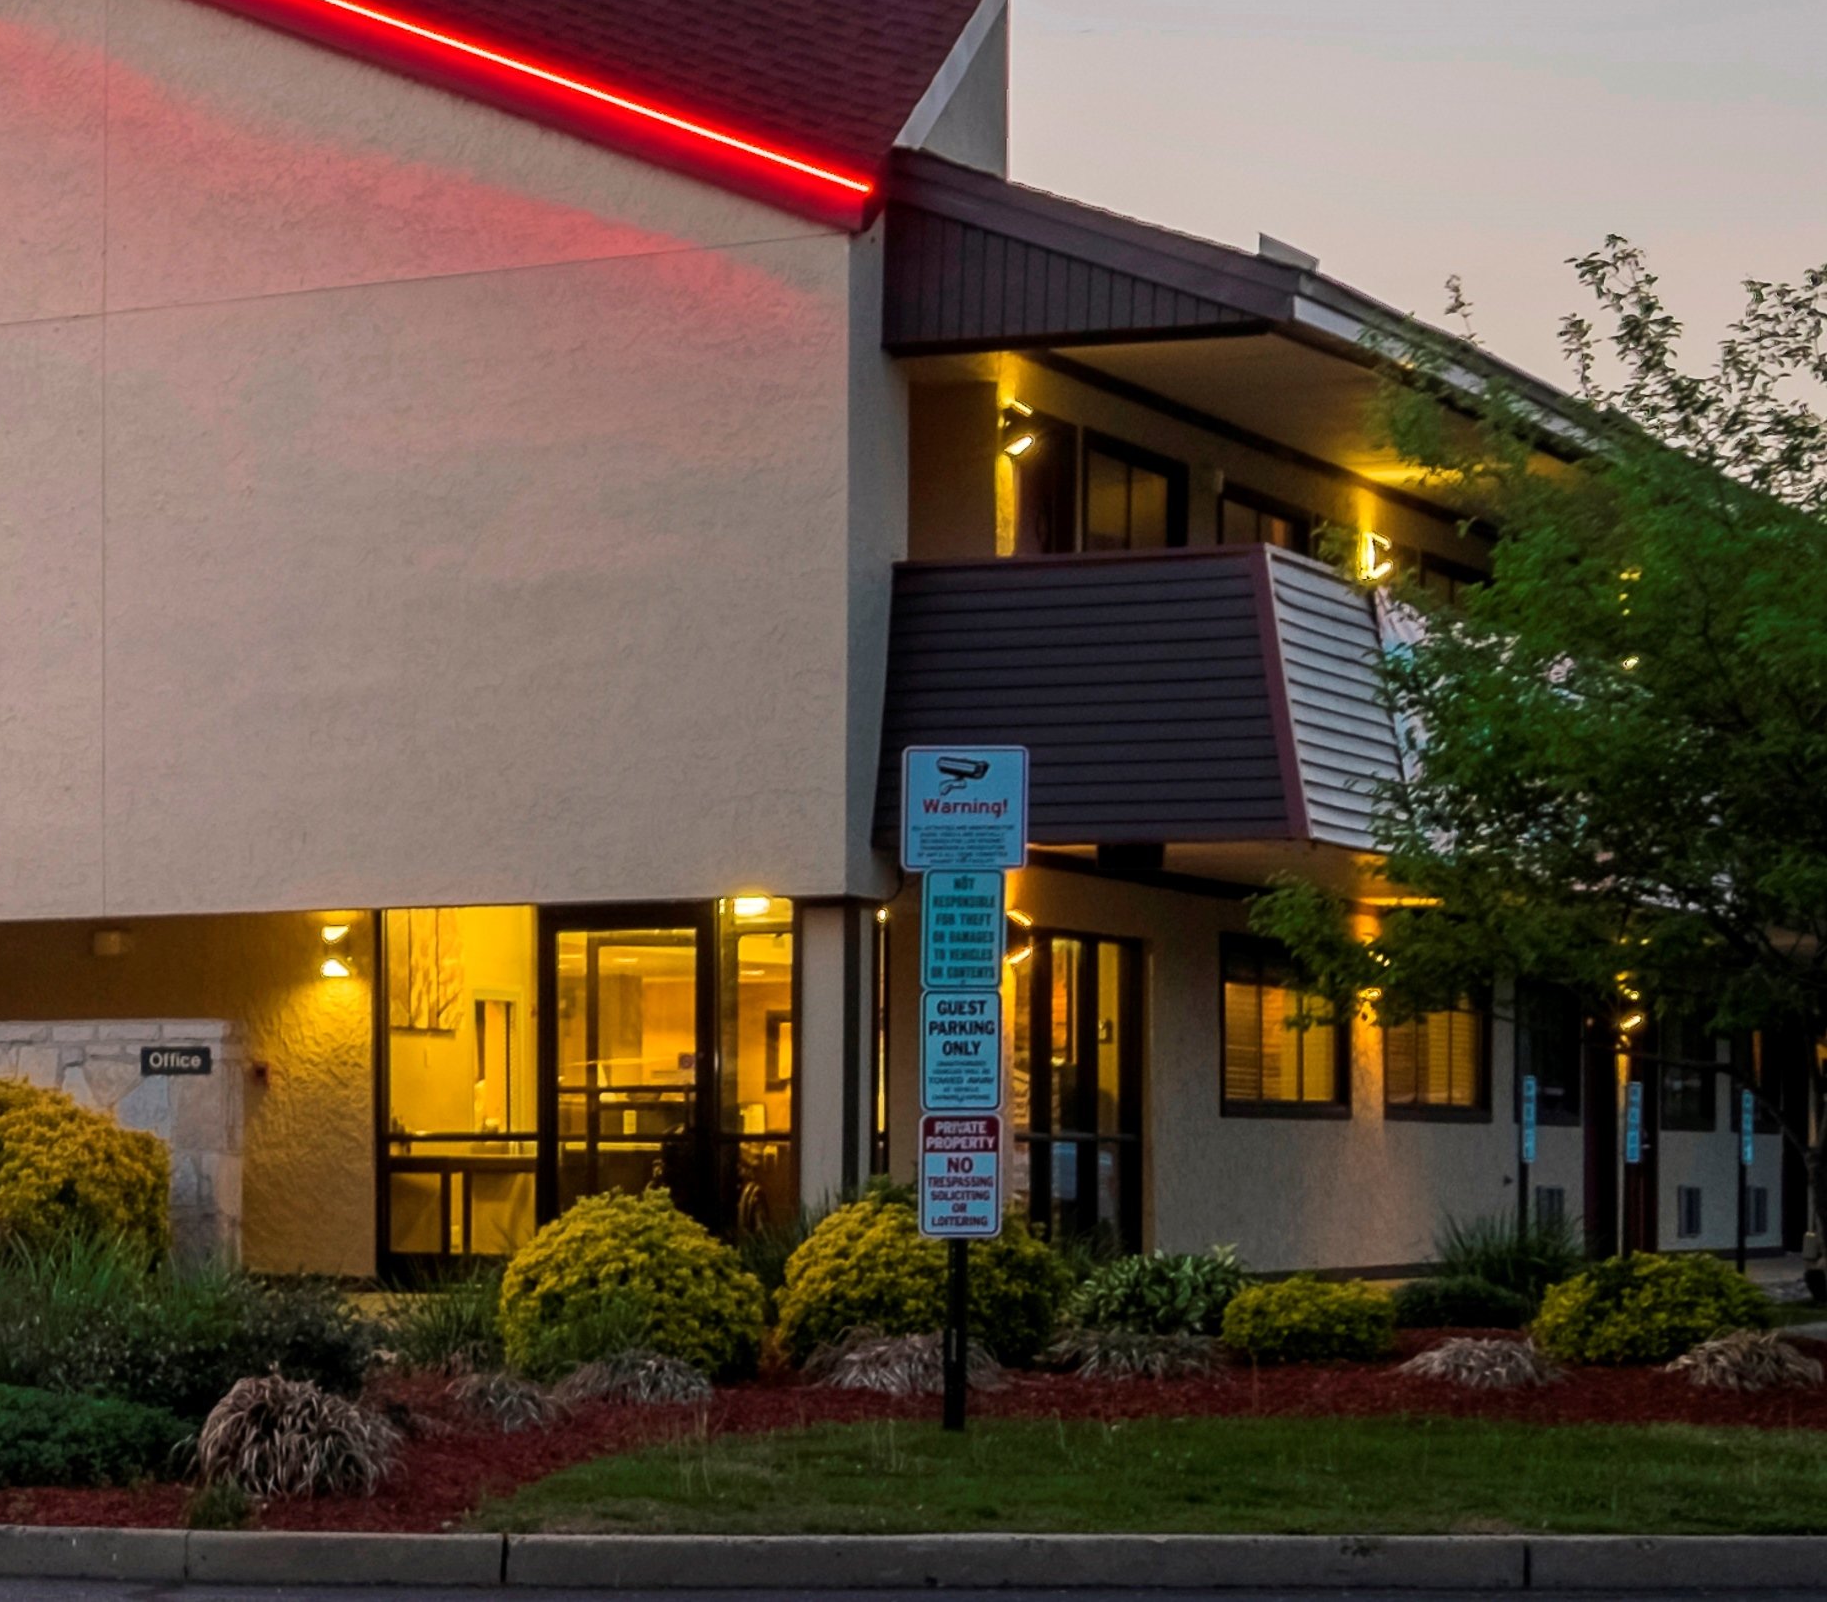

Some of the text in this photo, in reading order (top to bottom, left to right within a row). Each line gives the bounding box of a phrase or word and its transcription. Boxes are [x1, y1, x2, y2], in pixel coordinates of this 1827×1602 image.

[922, 798, 1008, 819] Warning!
[954, 877, 975, 890] NOT
[933, 895, 995, 908] RESPONSIBLE
[936, 913, 991, 925] FOR THEFT
[933, 931, 995, 943] OR DAMAGES
[934, 948, 993, 961] TO VEHICLES
[937, 1000, 987, 1015] GUEST
[929, 1021, 995, 1035] PARKING
[942, 1041, 981, 1056] ONLY
[149, 1051, 201, 1069] Office
[935, 1121, 987, 1134] PRIVATE
[926, 1137, 996, 1149] PROPERTY
[948, 1158, 974, 1173] NO
[928, 1177, 994, 1187] TRESPASSING
[931, 1190, 990, 1200] SOLICITING
[952, 1203, 967, 1213] OR
[932, 1216, 989, 1227] LOITERING
